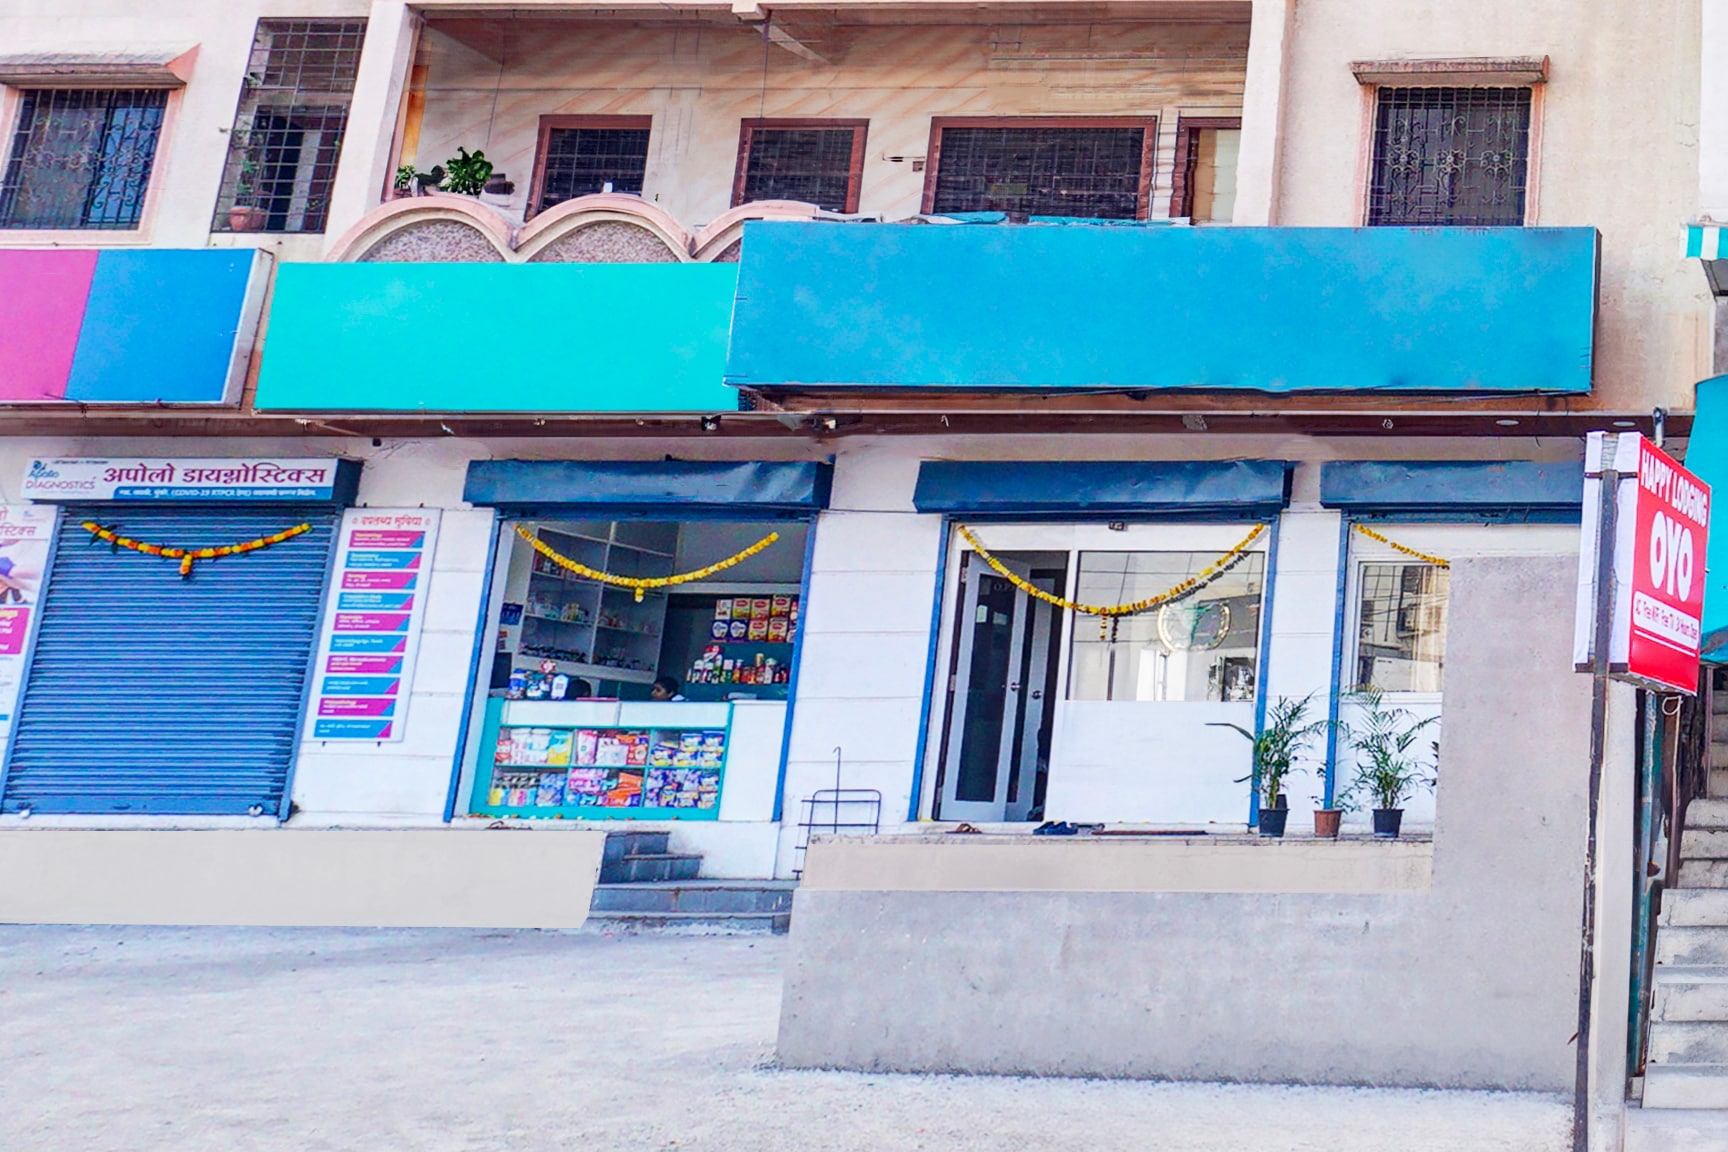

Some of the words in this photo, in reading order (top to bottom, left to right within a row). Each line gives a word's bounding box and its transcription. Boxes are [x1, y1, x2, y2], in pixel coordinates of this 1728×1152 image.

[25, 480, 95, 490] DIAGNOSTICS
[103, 462, 176, 484] अपोलो
[182, 461, 328, 484] डायग्नोस्टिक्स
[1641, 450, 1672, 503] HAPPY
[1672, 474, 1707, 528] LODGING
[1649, 510, 1694, 602] OYO
